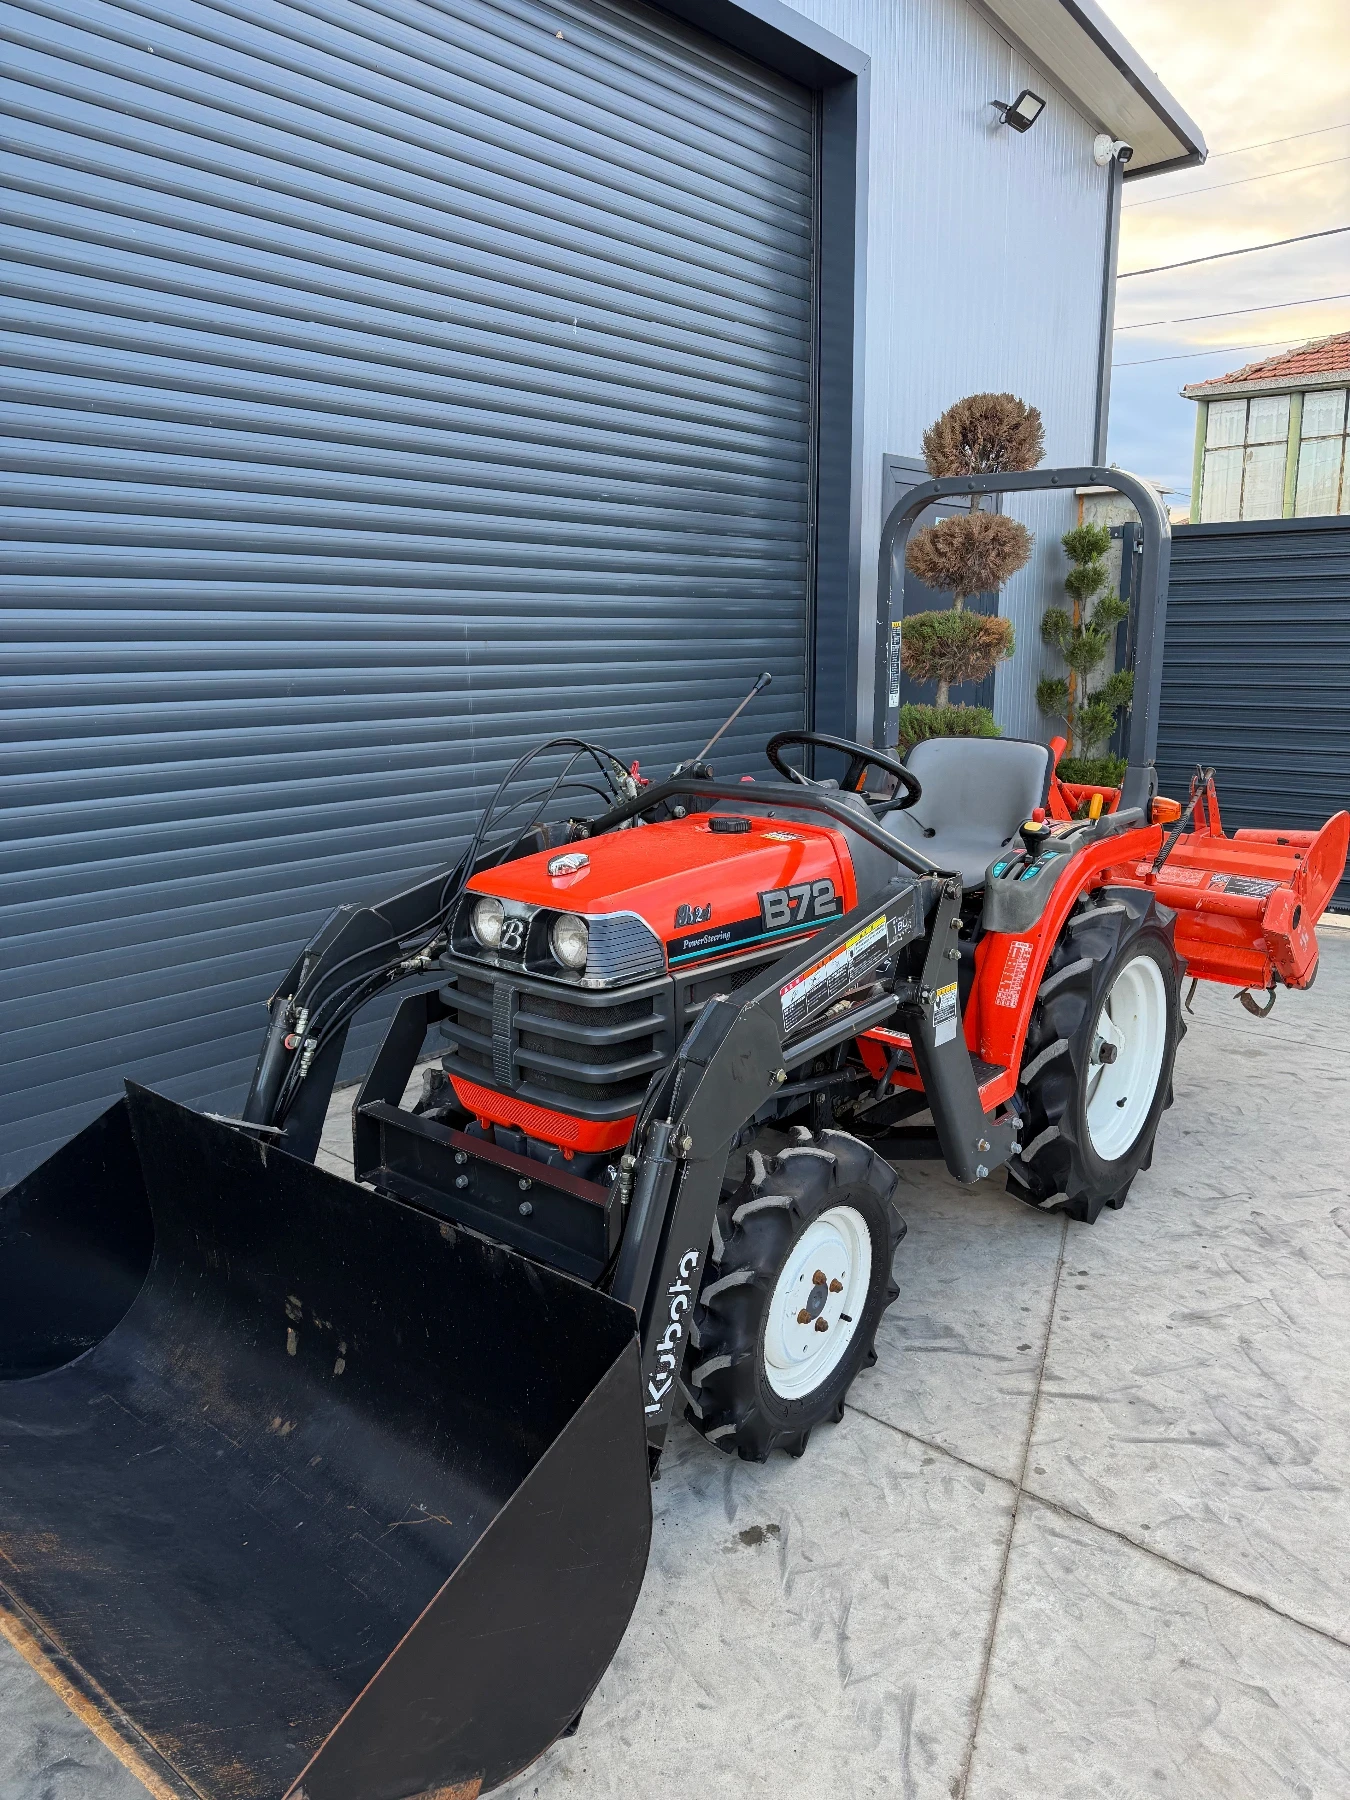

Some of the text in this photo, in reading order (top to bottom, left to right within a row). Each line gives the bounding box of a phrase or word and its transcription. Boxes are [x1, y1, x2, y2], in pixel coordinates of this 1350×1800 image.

[501, 918, 524, 951] B
[682, 930, 731, 950] PowerSteering
[644, 1249, 702, 1415] Kubota
